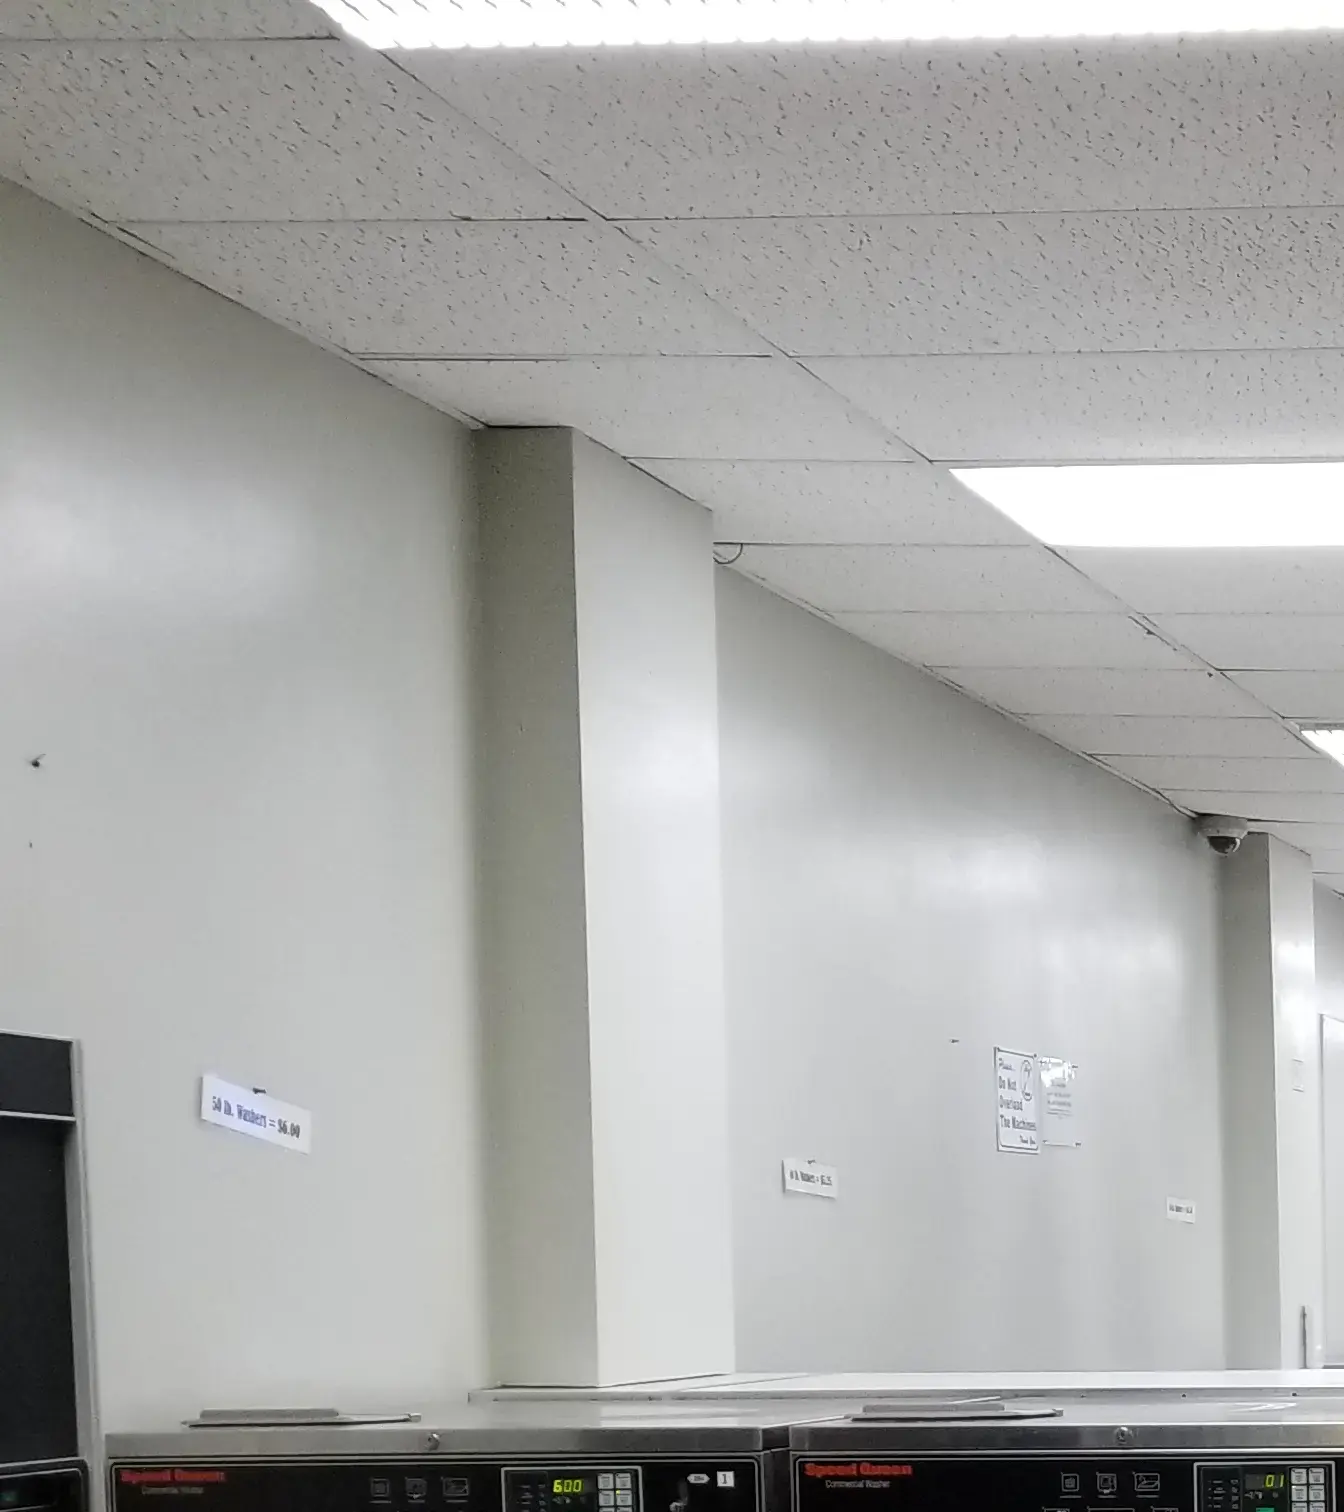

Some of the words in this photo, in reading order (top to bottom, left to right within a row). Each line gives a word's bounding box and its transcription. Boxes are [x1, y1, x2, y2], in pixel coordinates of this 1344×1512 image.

[1000, 1114, 1011, 1129] The
[553, 1479, 583, 1493] 600
[1265, 1474, 1285, 1488] 01
